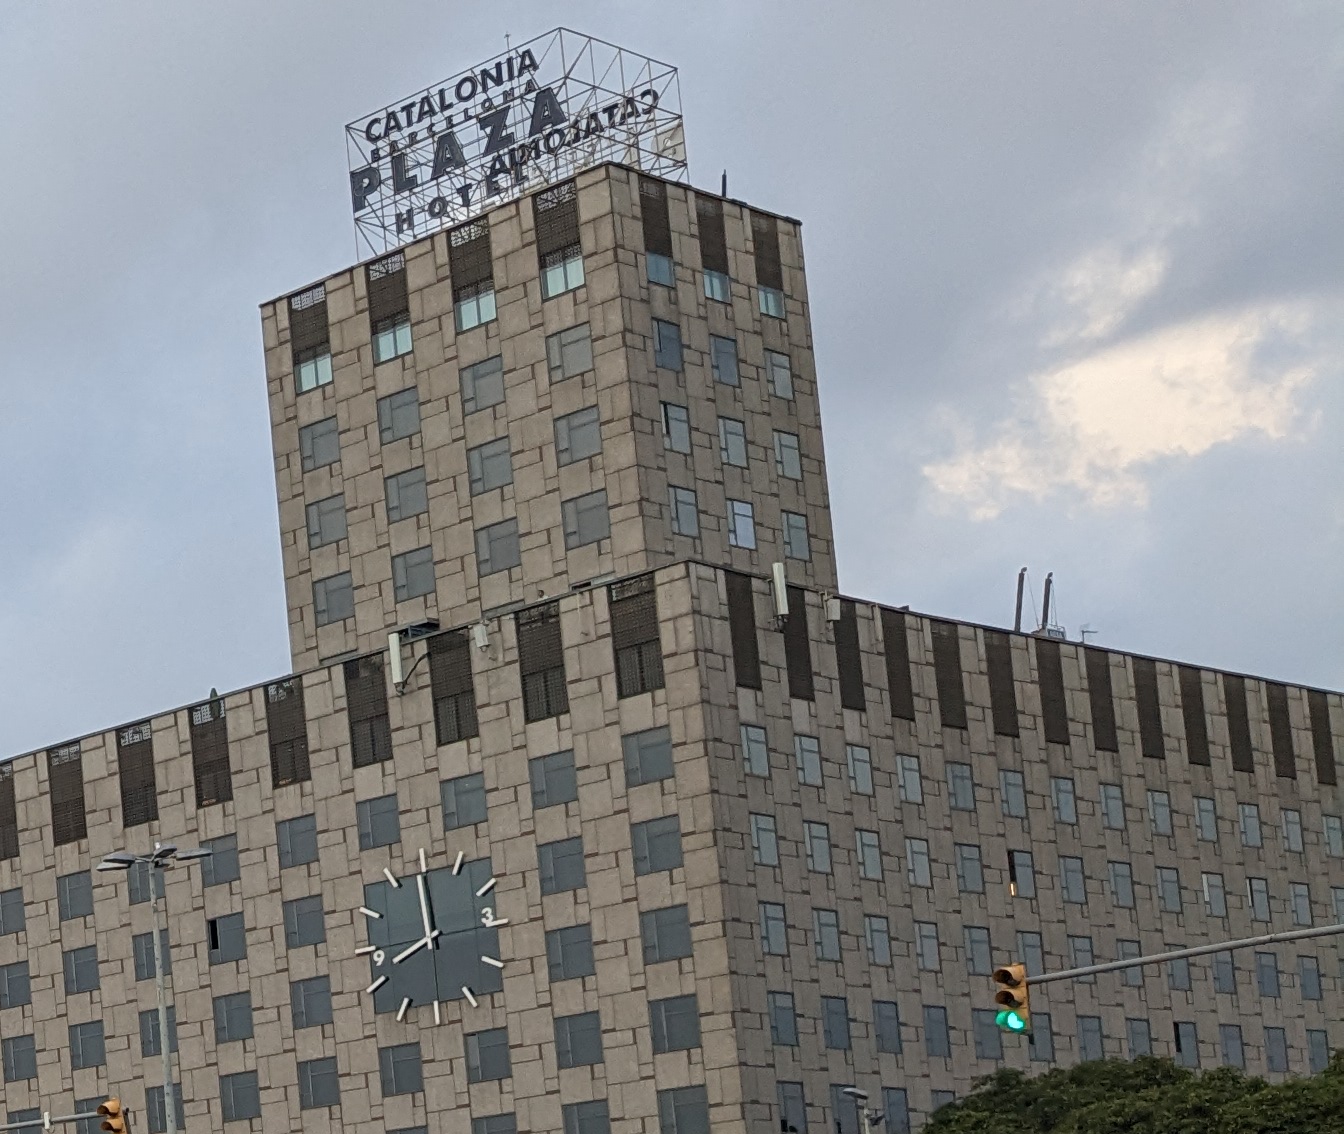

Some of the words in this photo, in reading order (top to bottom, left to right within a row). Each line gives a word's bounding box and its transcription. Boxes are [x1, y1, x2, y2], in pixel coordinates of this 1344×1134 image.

[365, 48, 540, 144] CATALONIA
[370, 78, 538, 163] BARCELONA
[349, 86, 567, 213] PLAZA
[395, 165, 530, 235] HOTEL
[373, 950, 385, 967] 9
